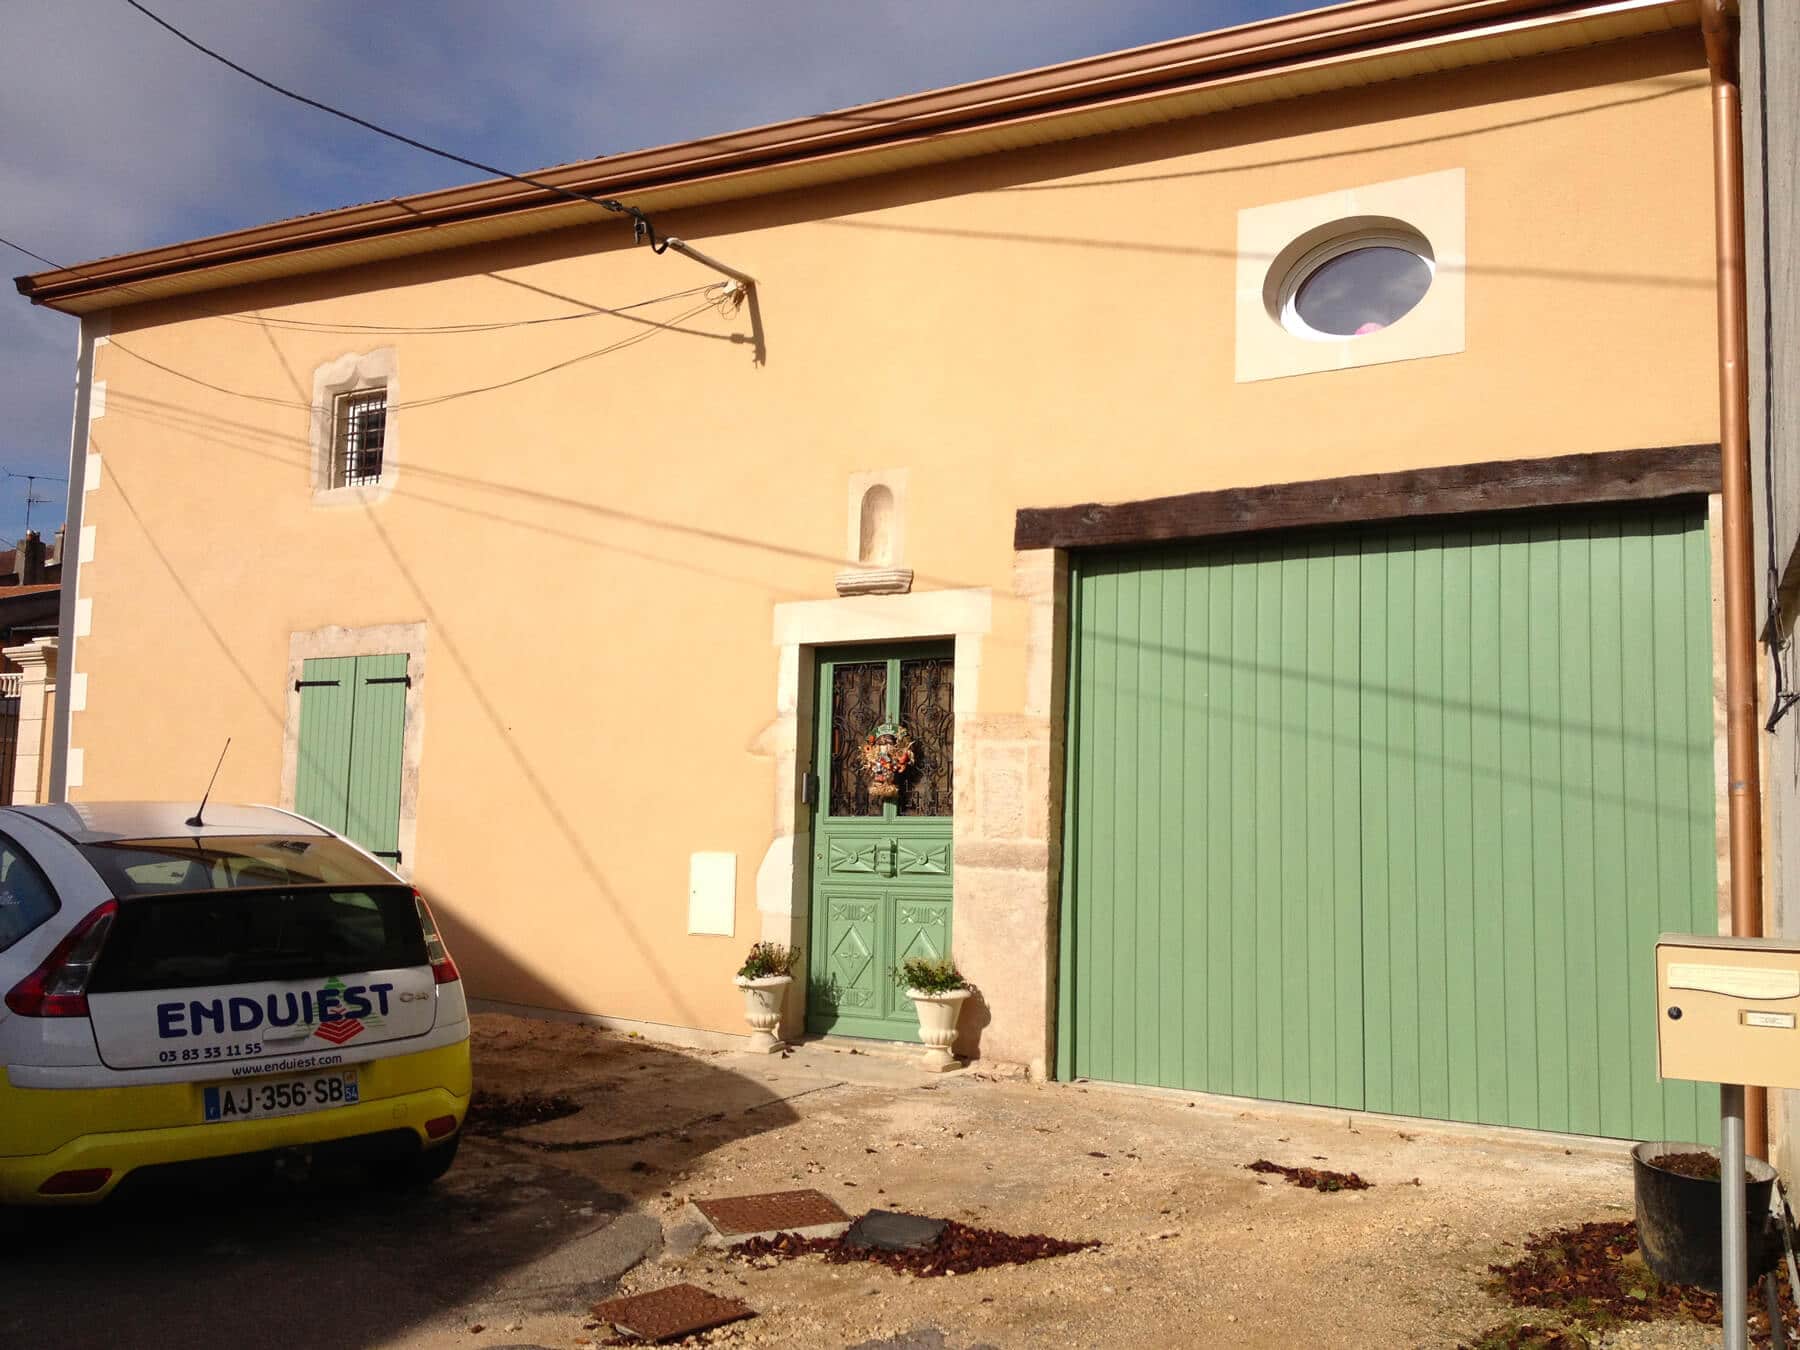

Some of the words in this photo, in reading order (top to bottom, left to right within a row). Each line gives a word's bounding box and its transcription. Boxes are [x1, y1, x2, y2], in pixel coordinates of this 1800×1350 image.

[157, 983, 393, 1038] ENDUIEST
[159, 1050, 177, 1062] 03
[182, 1048, 200, 1061] 83
[204, 1046, 221, 1059] 33
[226, 1044, 241, 1057] 11
[245, 1042, 262, 1054] 55
[231, 1053, 343, 1077] www.enduiest.com
